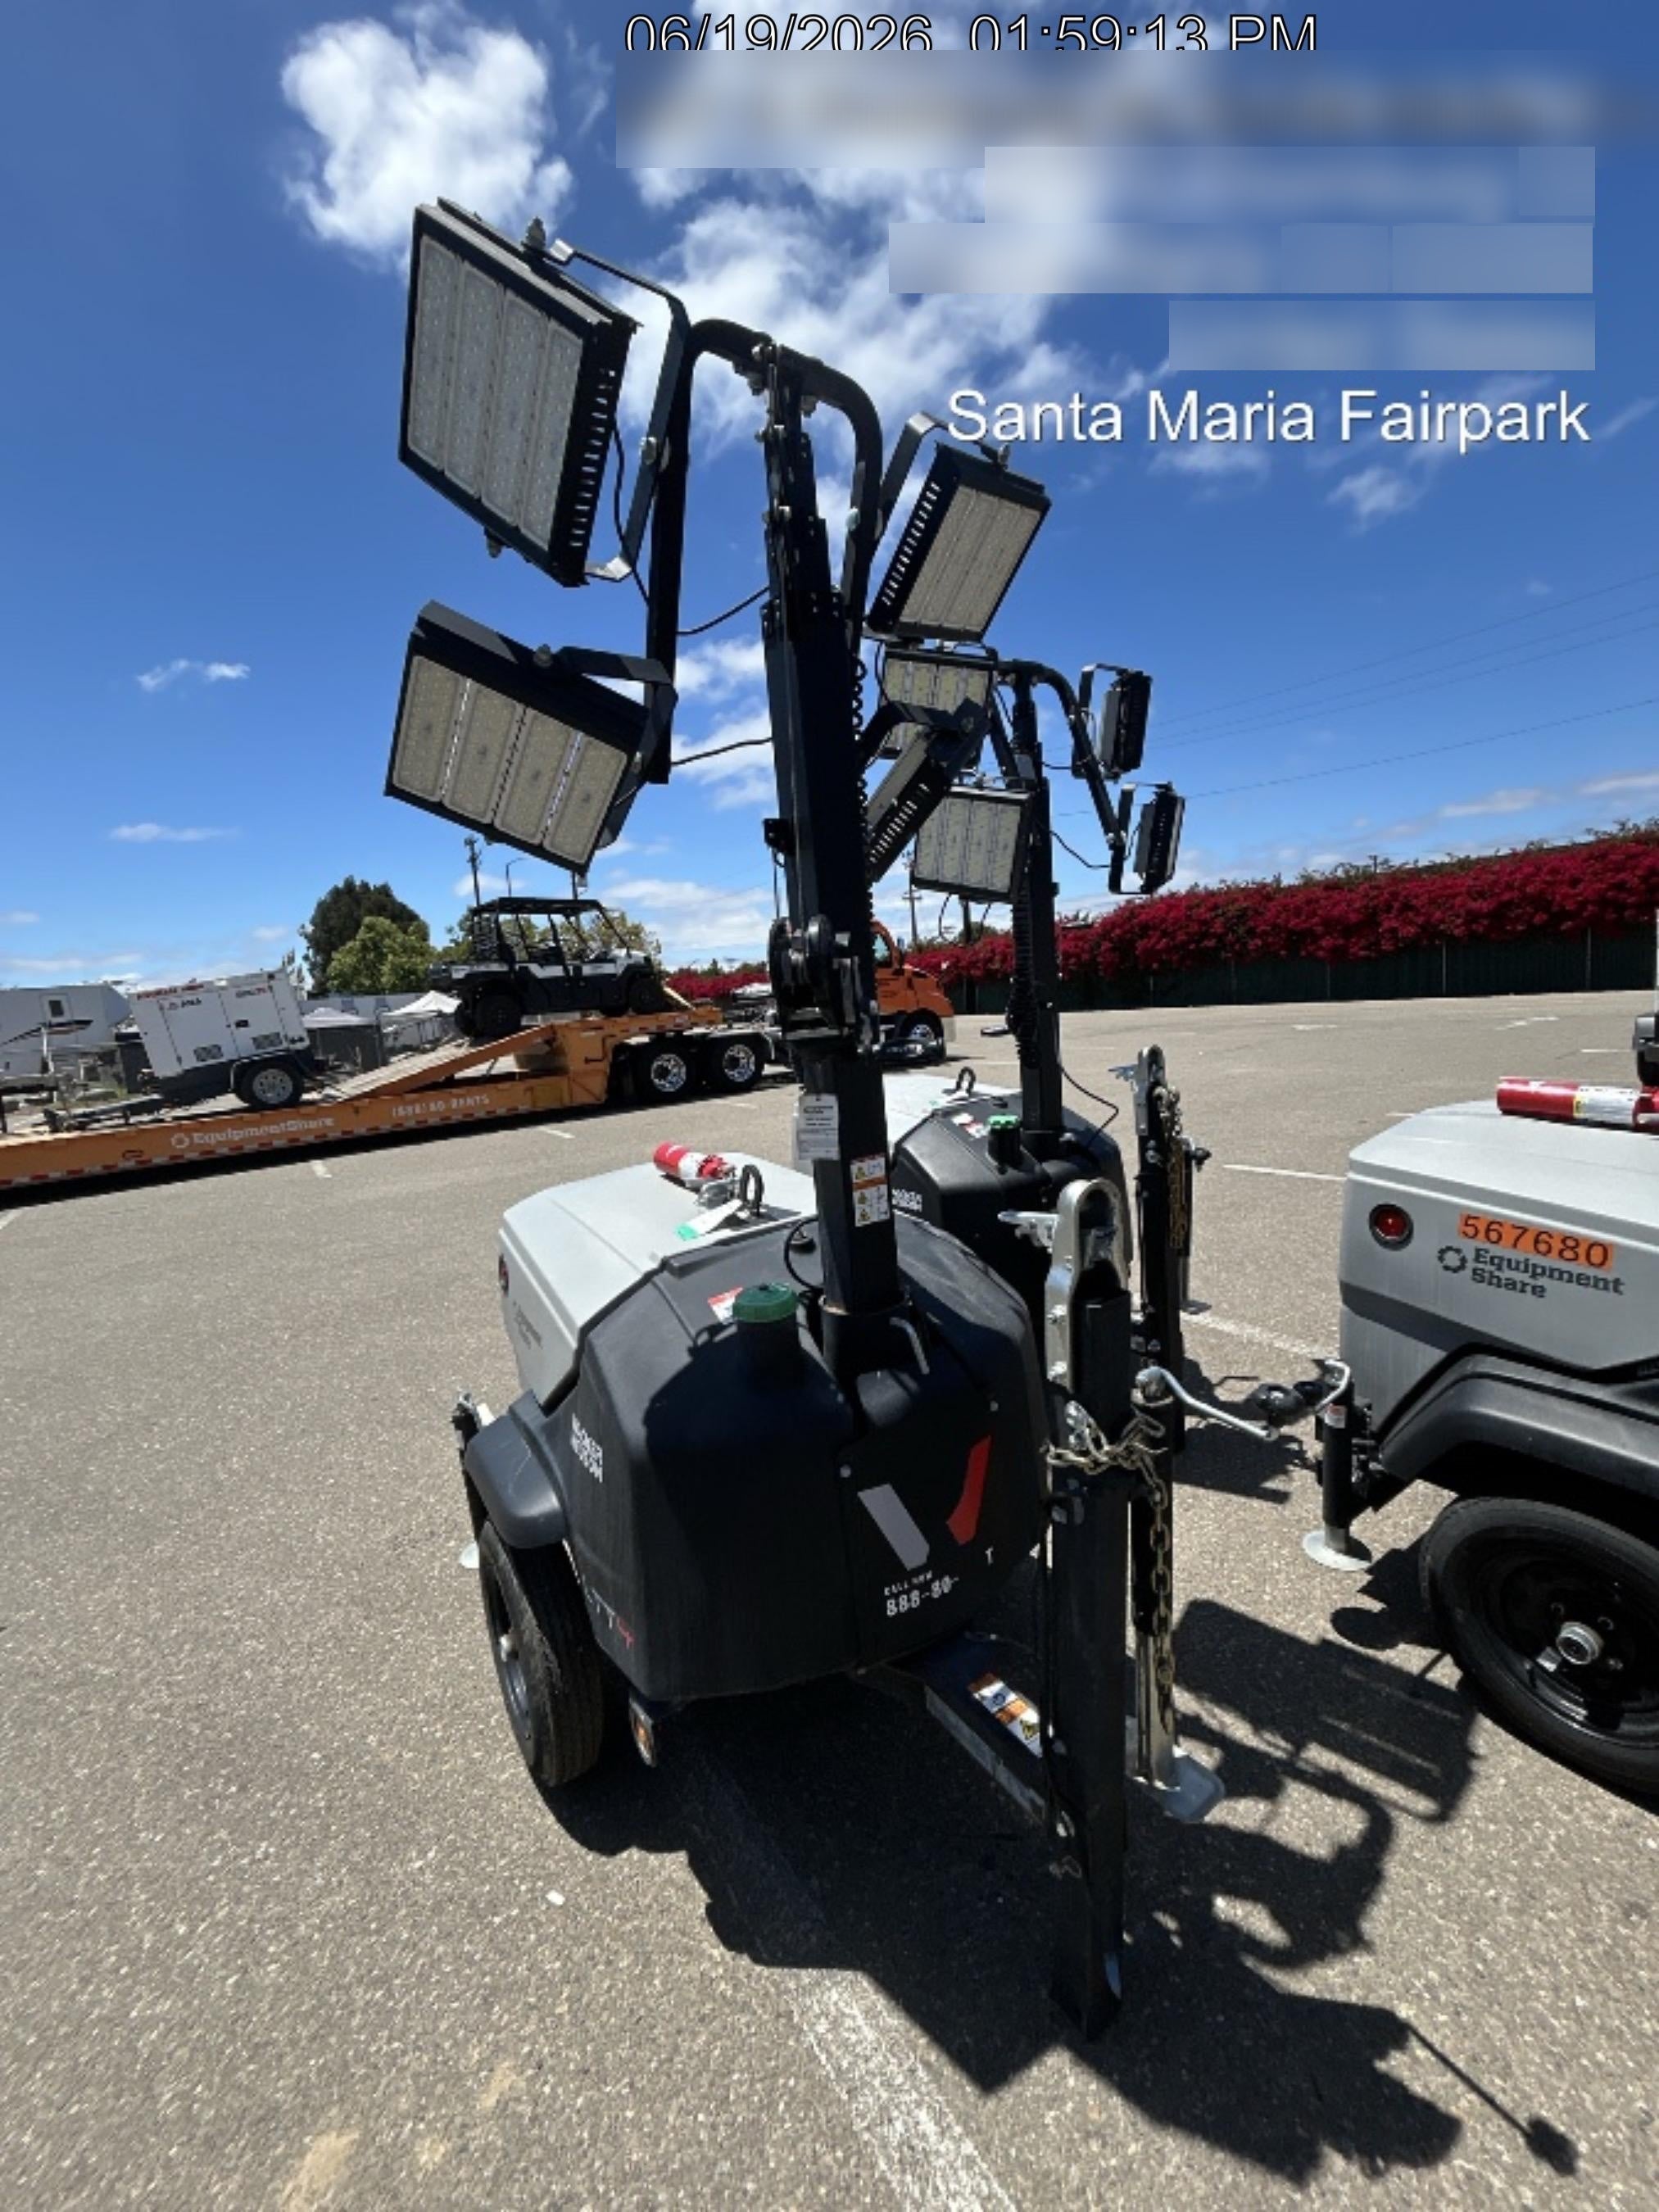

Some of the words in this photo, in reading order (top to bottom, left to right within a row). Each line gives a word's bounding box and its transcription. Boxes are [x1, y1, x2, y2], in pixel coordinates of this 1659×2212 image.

[193, 1117, 334, 1145] EquipmentShare
[1462, 1213, 1609, 1269] 567680
[1471, 1267, 1548, 1299] Share
[1473, 1247, 1625, 1295] Equipment
